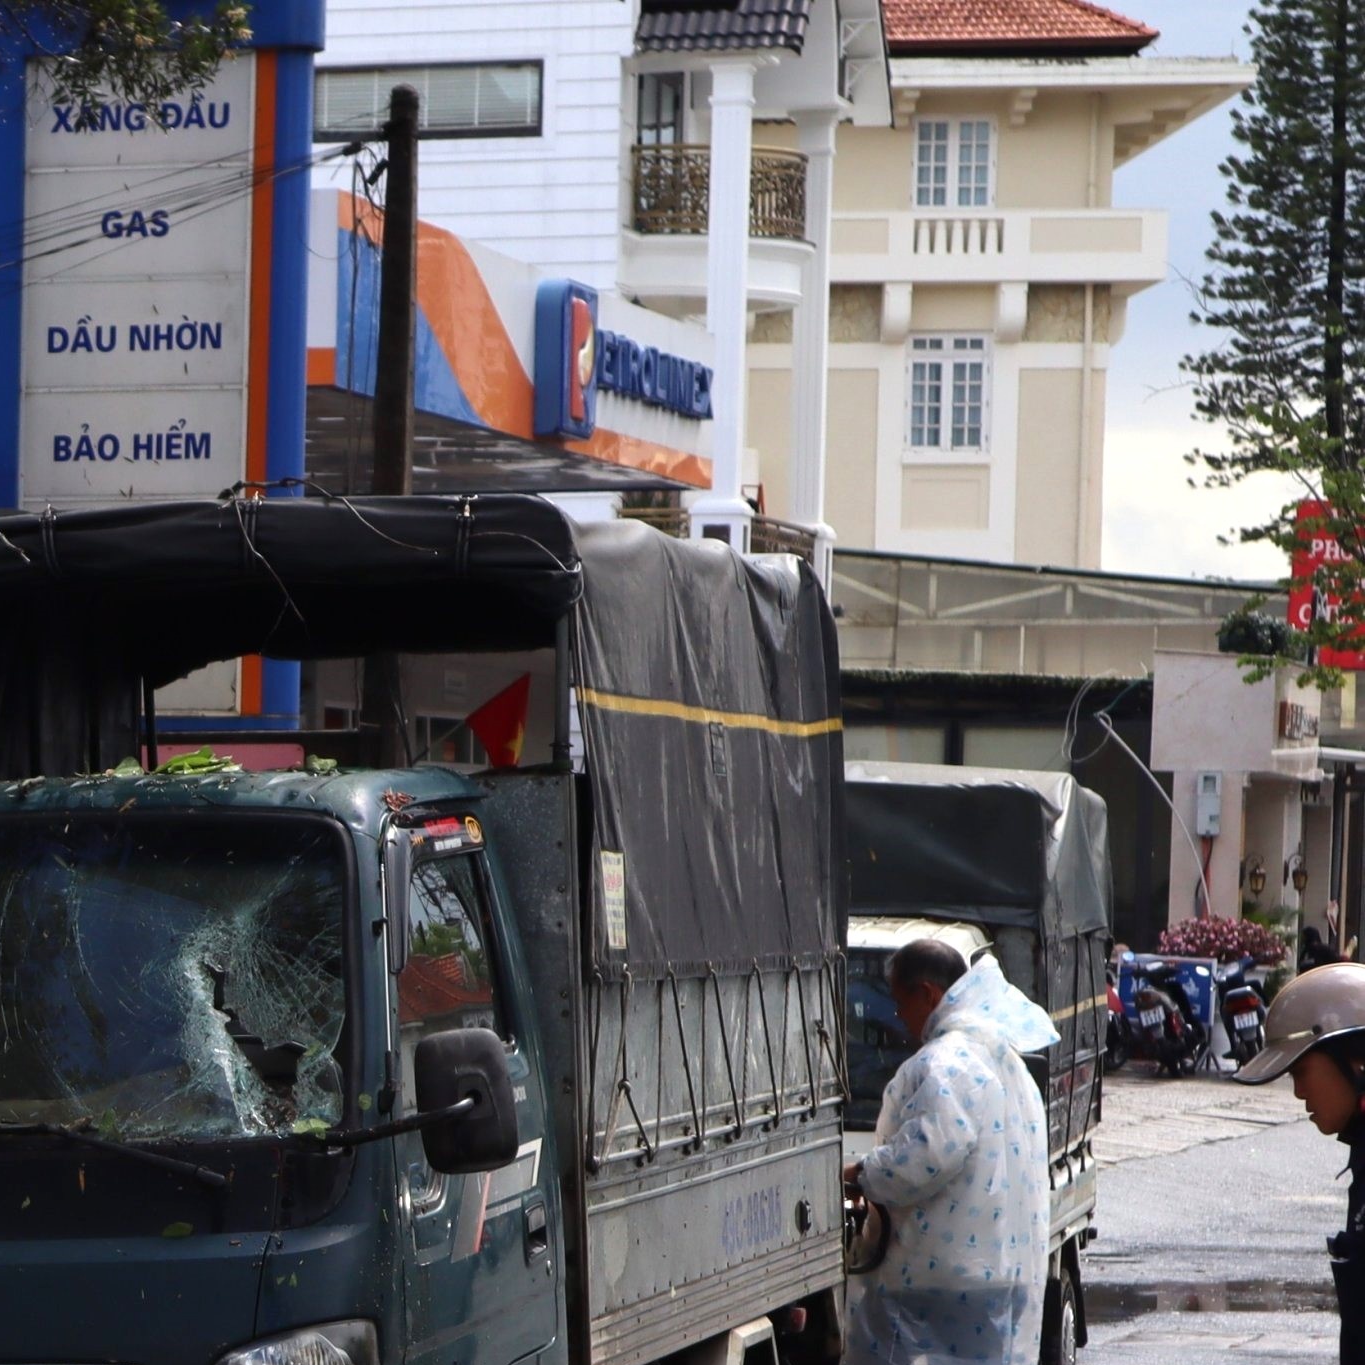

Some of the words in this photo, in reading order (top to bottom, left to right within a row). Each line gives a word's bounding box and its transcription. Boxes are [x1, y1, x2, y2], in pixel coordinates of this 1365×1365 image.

[101, 210, 170, 239] GAS
[47, 314, 117, 354] DẦU
[129, 314, 223, 351] NHỜN
[53, 423, 120, 462] BẢO
[133, 418, 212, 461] HIỂM
